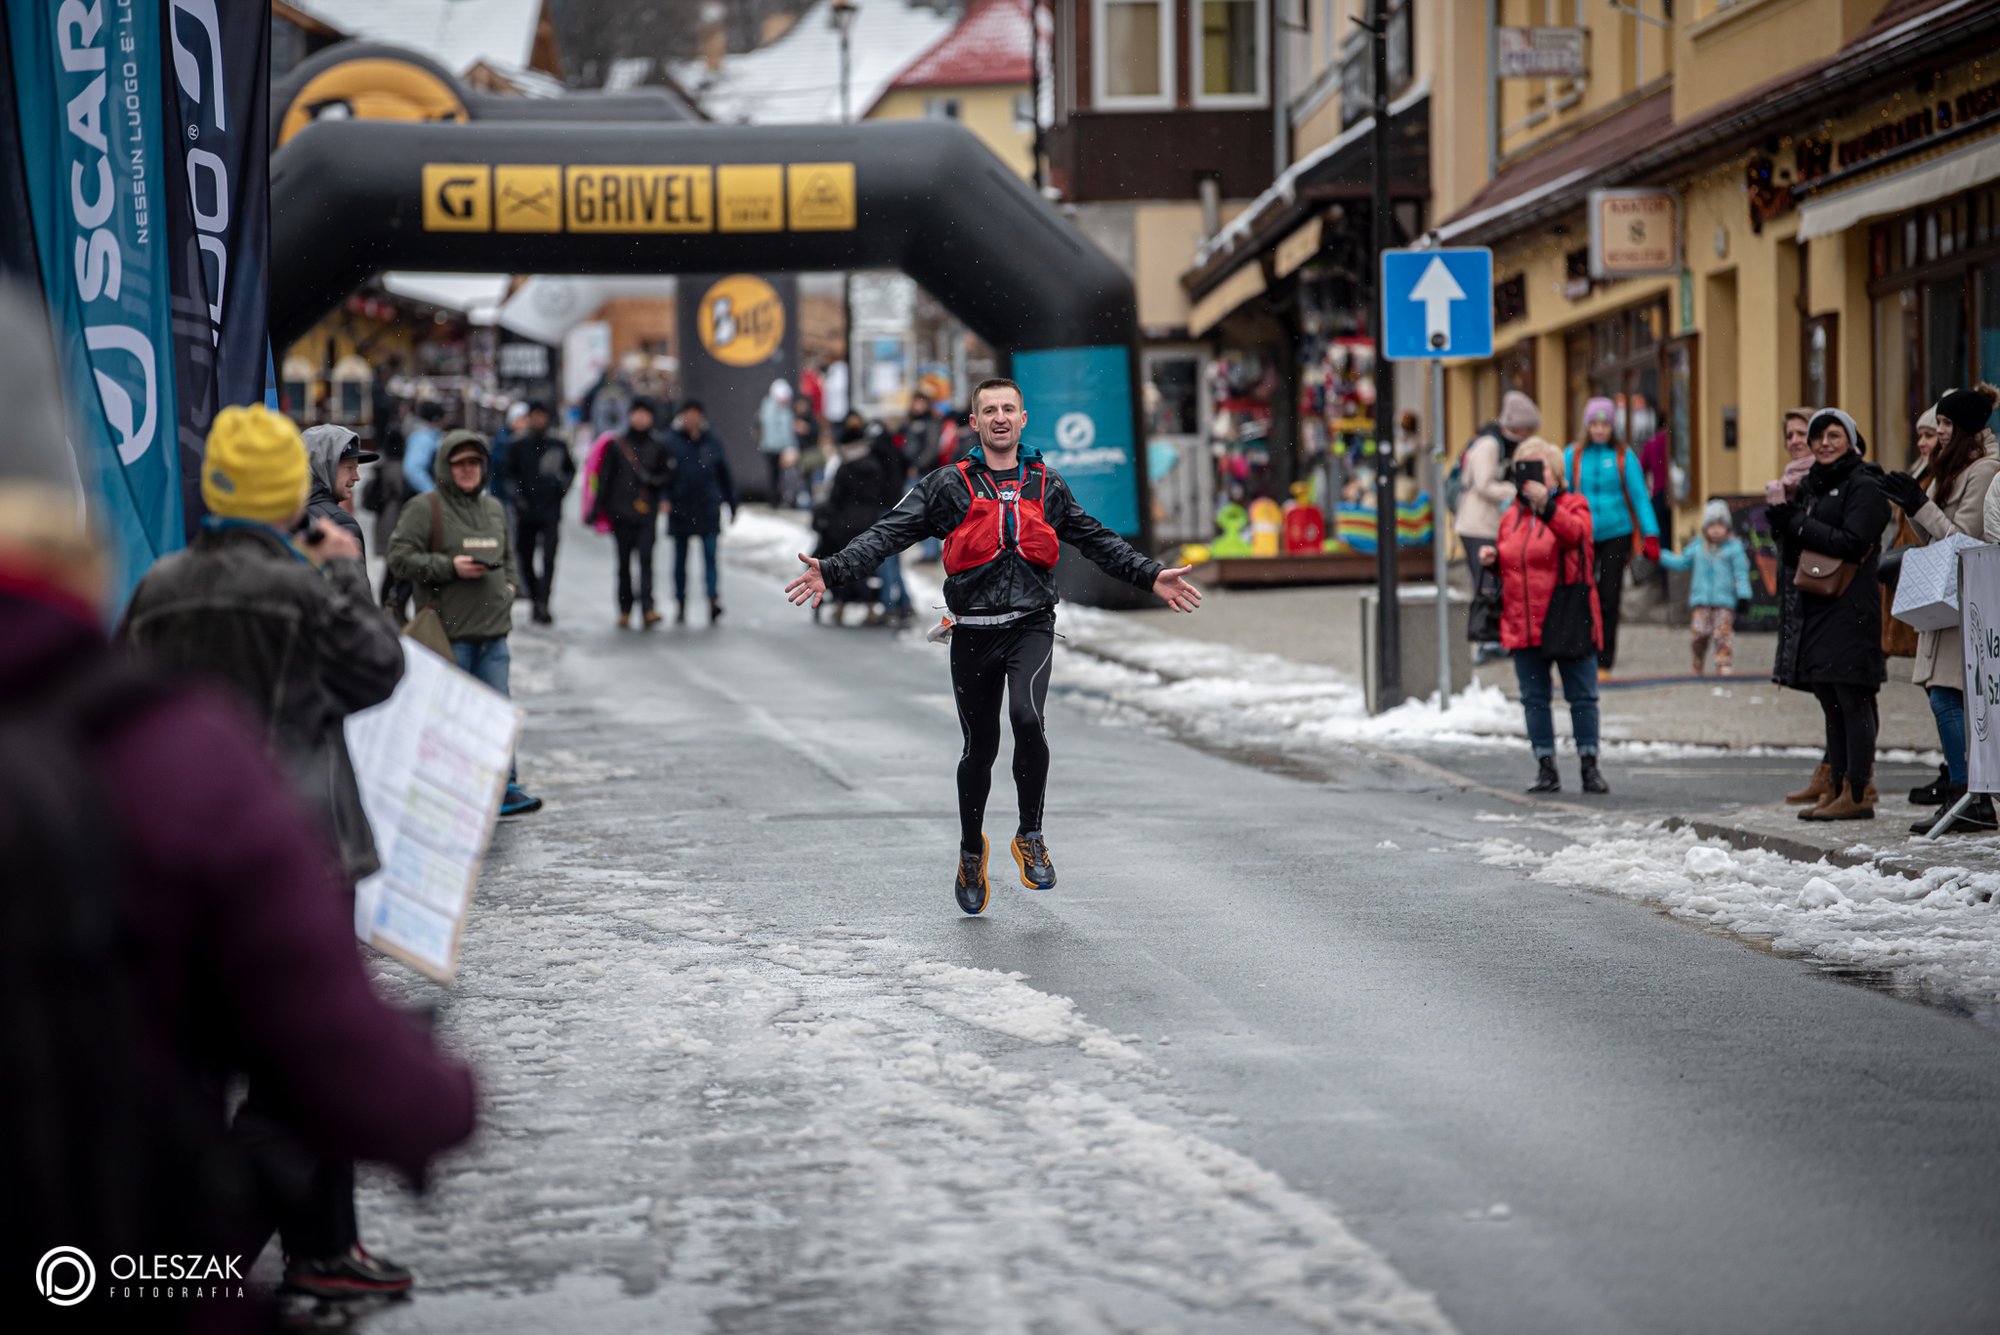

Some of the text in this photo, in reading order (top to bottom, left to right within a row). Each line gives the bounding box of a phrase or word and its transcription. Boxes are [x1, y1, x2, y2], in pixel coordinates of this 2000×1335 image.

[123, 62, 142, 142] LUOGO
[131, 149, 149, 244] NESSUN
[574, 174, 704, 223] GRIVEL
